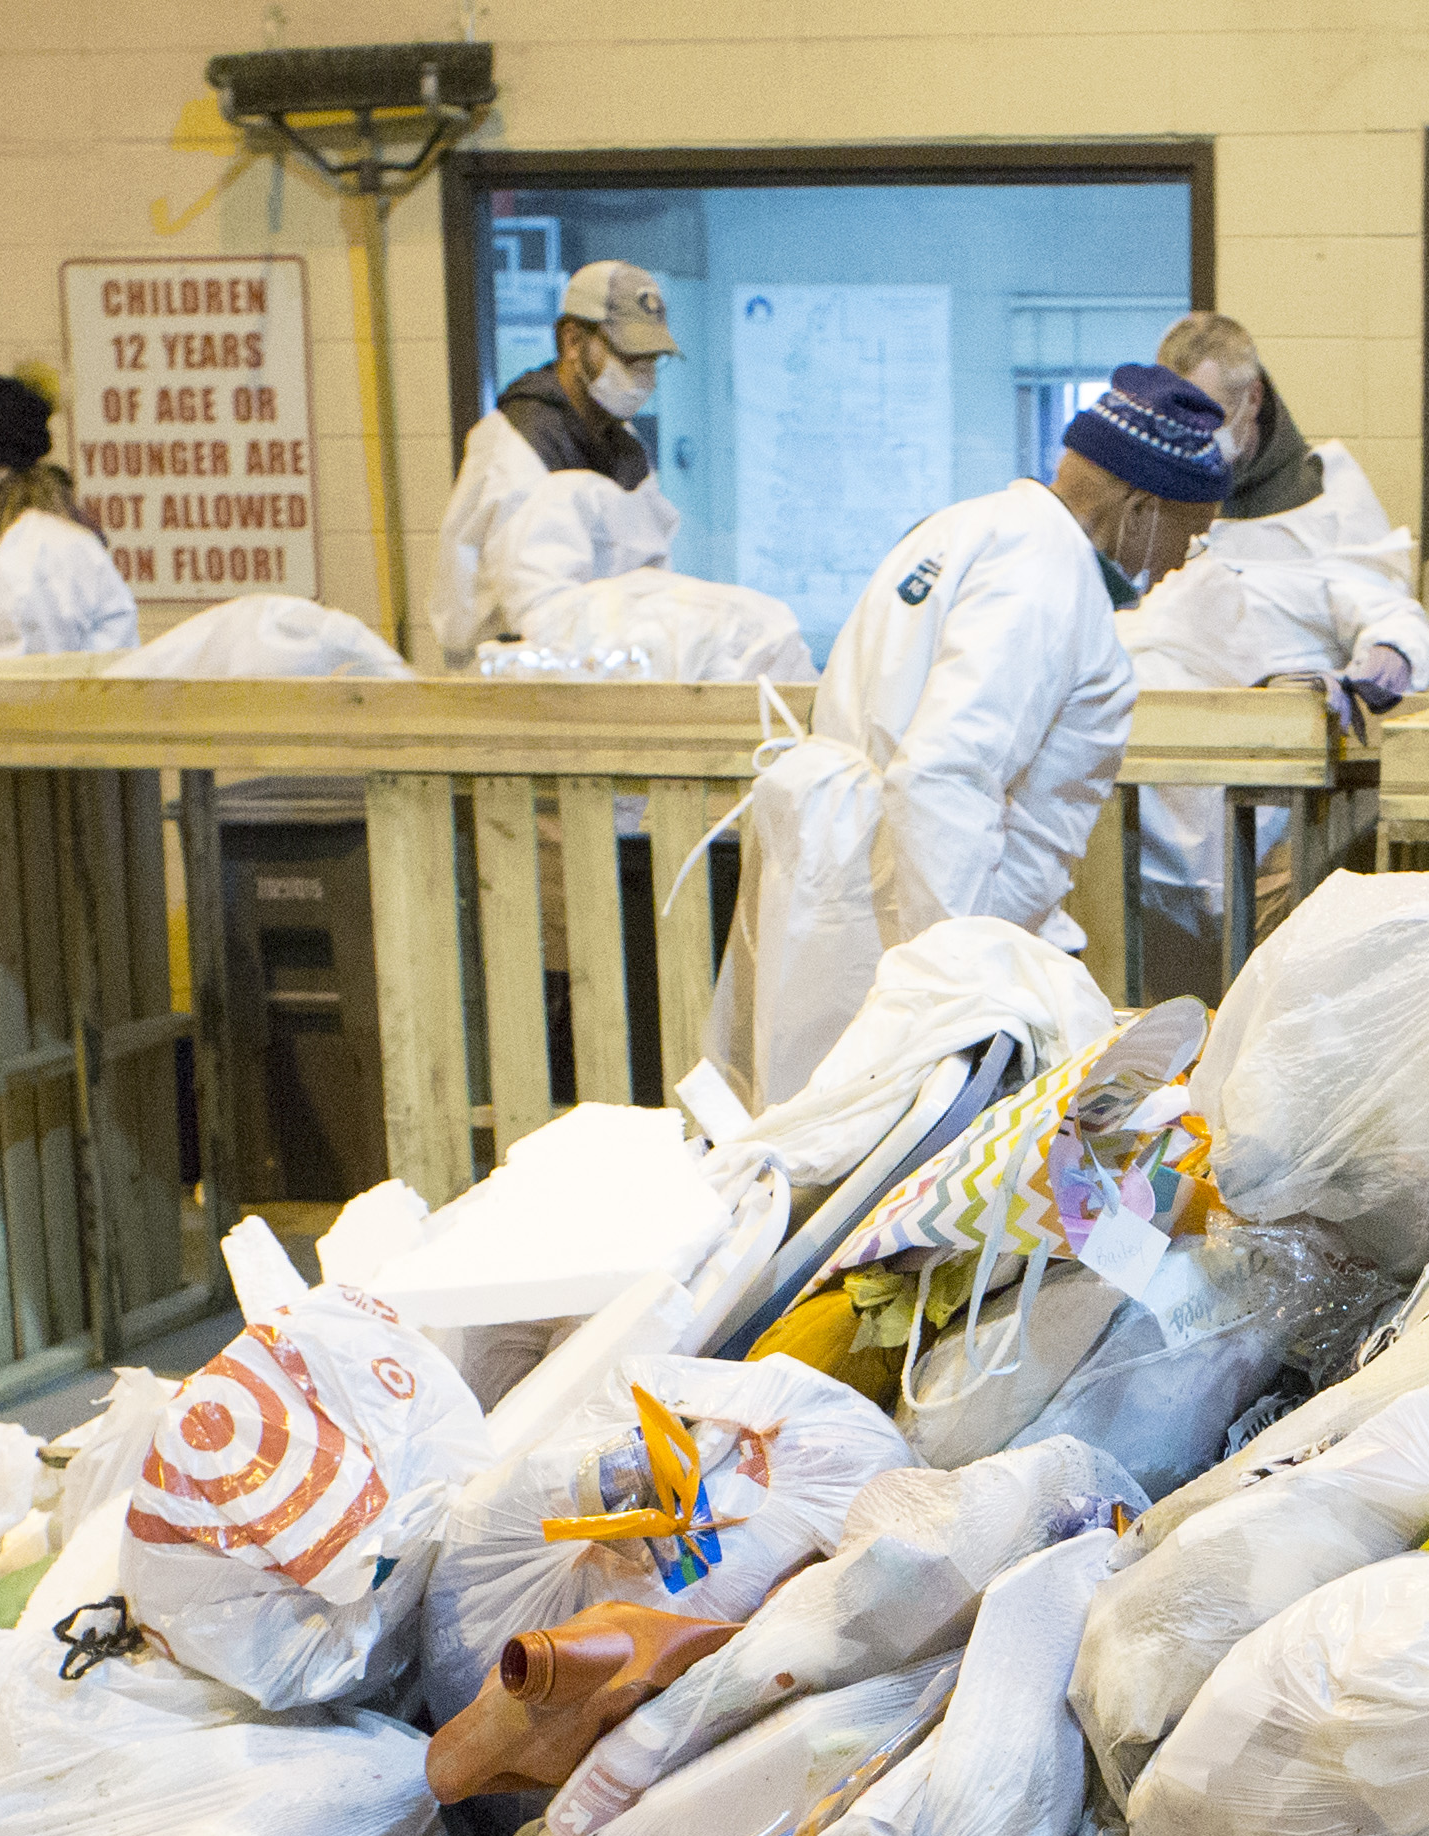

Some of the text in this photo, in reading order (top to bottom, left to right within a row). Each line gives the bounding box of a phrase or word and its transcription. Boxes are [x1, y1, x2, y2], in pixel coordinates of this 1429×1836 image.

[101, 278, 267, 318] CHILDREN
[111, 332, 265, 370] 12 YEARS
[101, 386, 277, 424] OF AGE OR
[81, 440, 306, 477] YOUNGER ARE
[82, 494, 308, 531] NOT ALLOWED
[112, 547, 286, 585] ON FLOOR!
